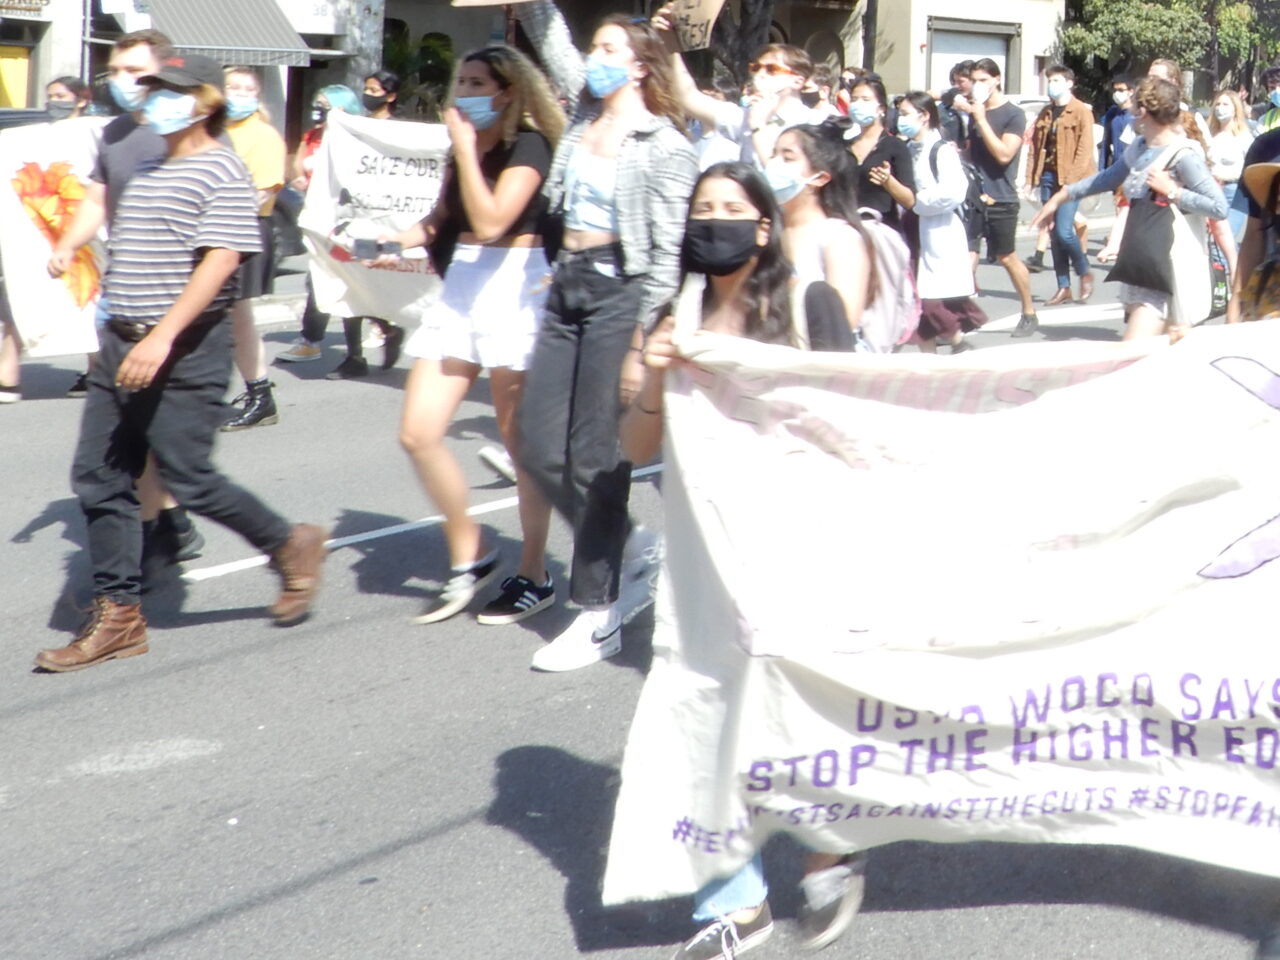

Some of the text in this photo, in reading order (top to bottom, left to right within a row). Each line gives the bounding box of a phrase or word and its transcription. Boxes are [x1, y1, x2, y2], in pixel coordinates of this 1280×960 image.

[356, 155, 439, 179] SAVE OUR
[1009, 672, 1154, 728] WOCO
[746, 743, 879, 792] STOP
[899, 728, 989, 775] THE
[1011, 717, 1198, 766] HIGHER
[1223, 726, 1280, 770] ED
